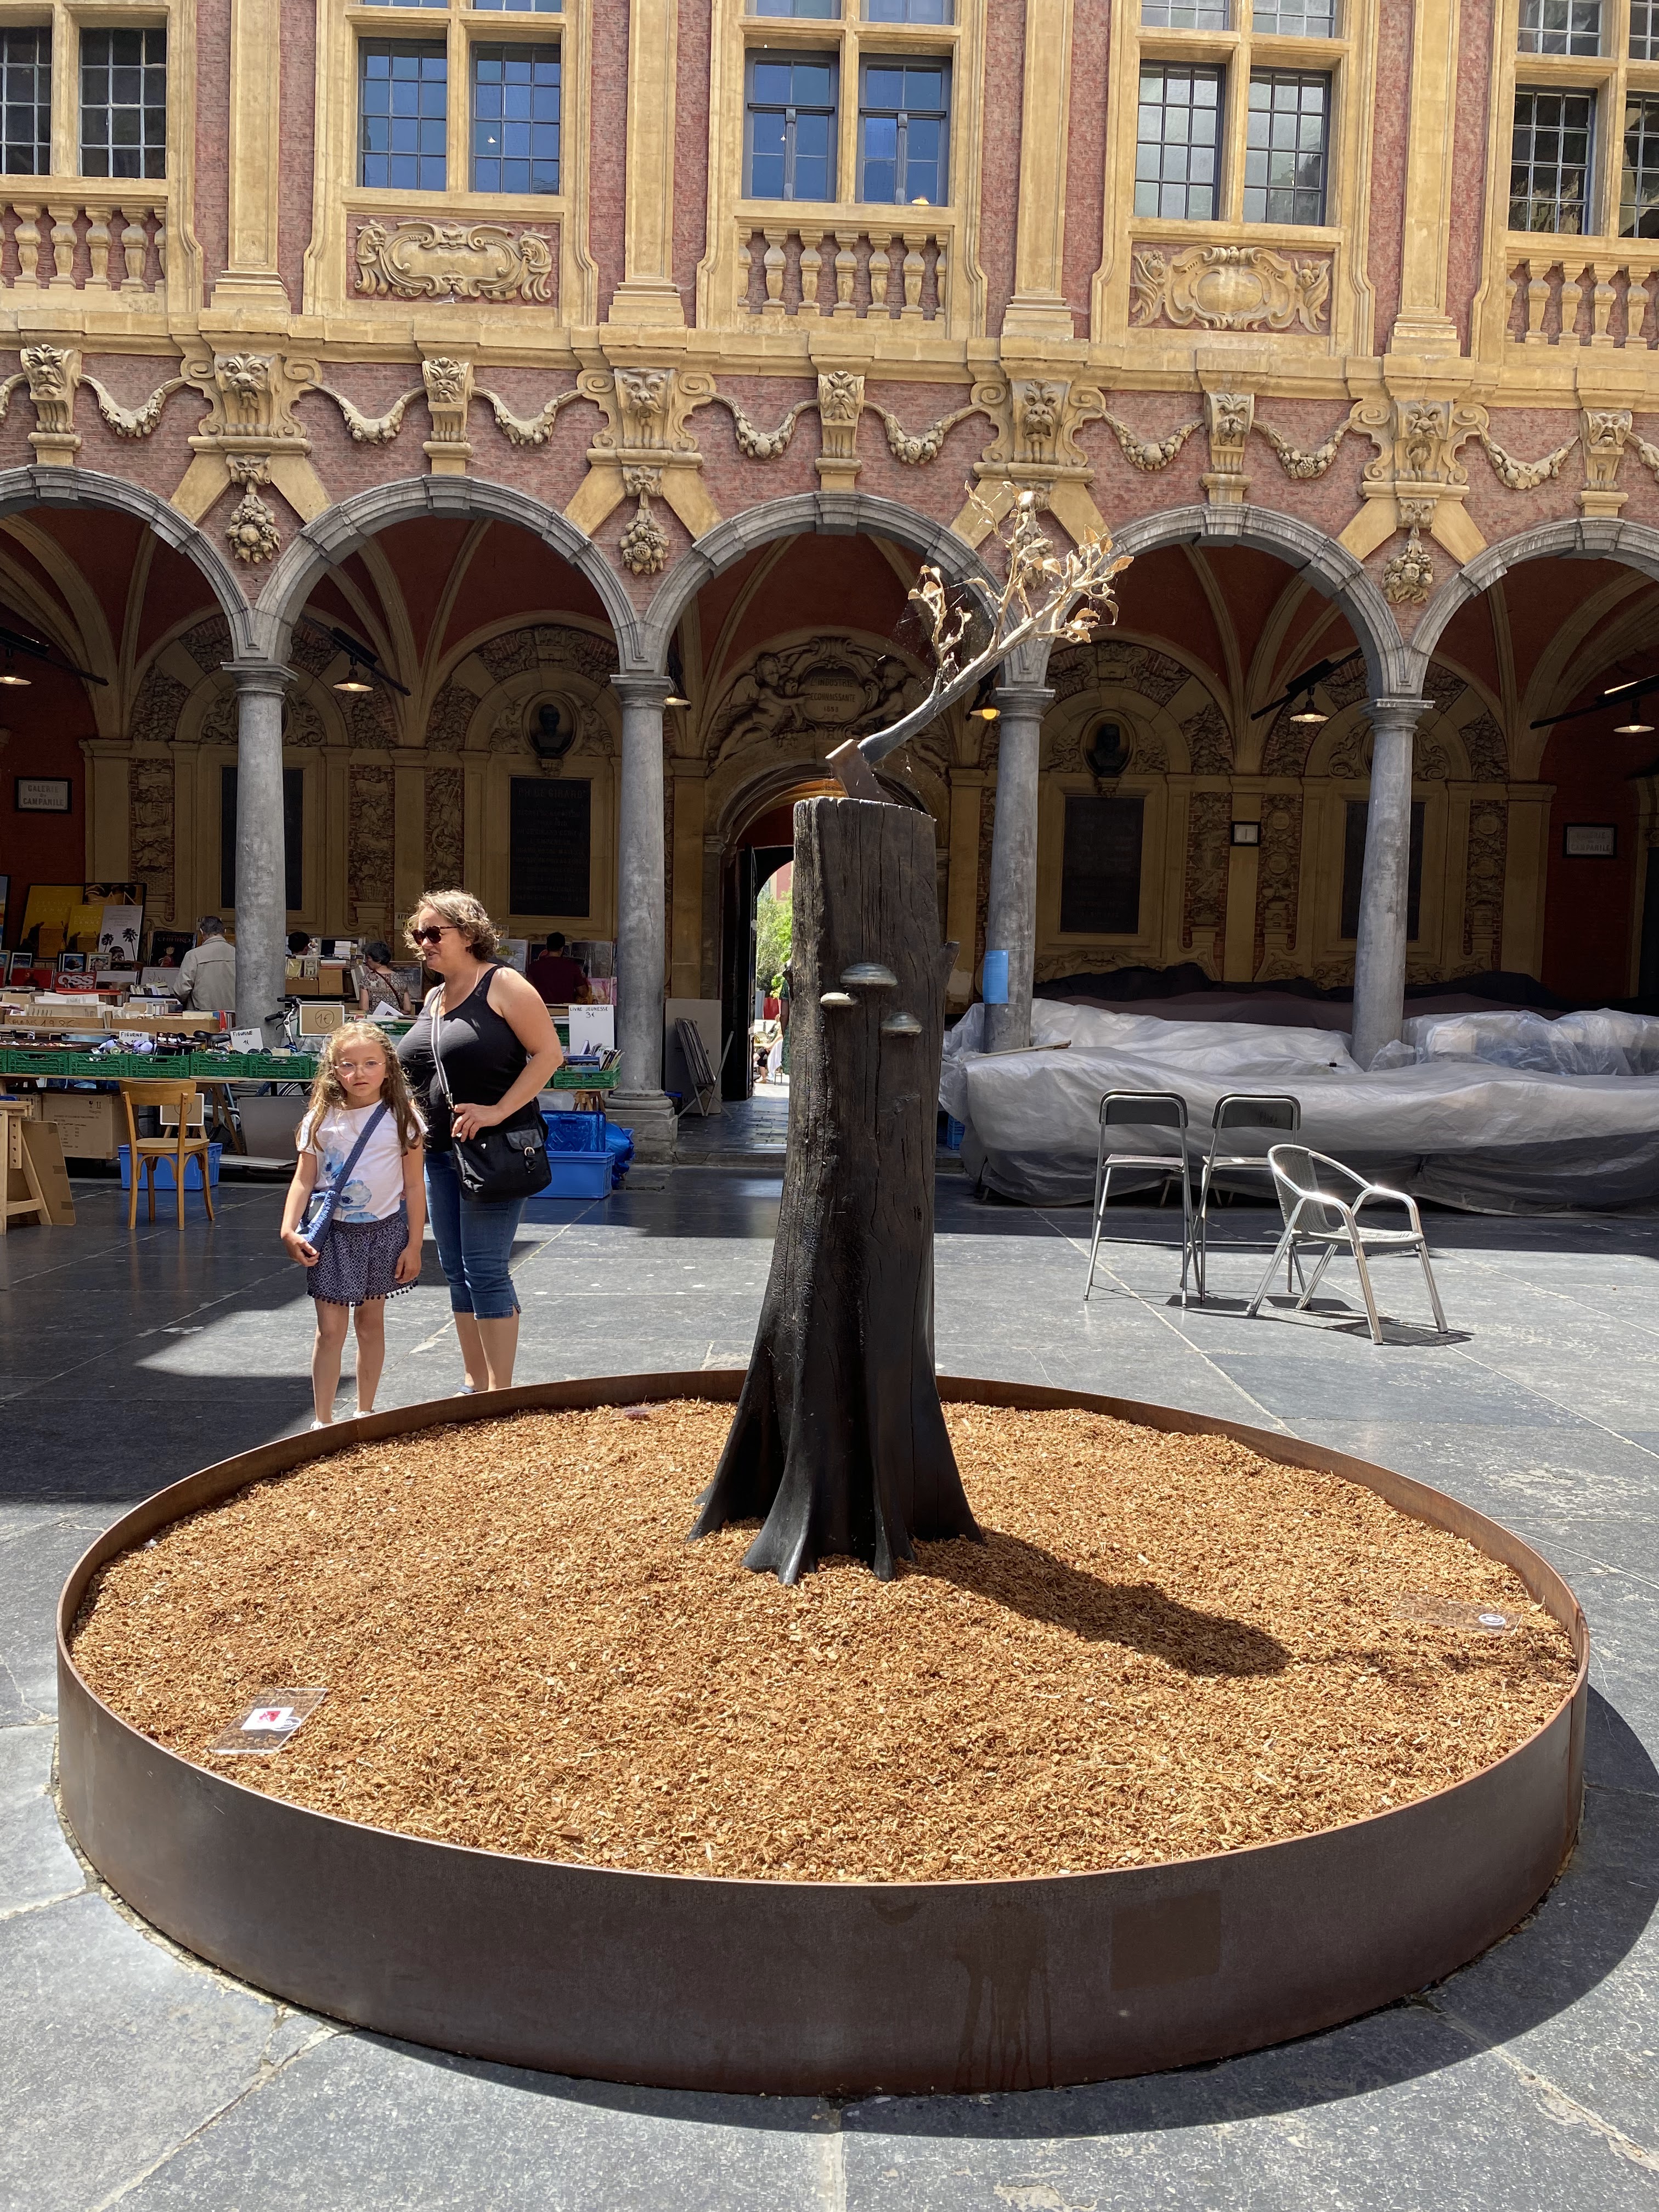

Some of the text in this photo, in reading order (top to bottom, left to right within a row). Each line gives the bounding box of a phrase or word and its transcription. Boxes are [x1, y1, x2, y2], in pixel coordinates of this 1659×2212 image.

[27, 785, 59, 793] GALERIE
[22, 798, 64, 806] CAMPANILE
[58, 974, 94, 985] OSS
[316, 1013, 332, 1024] 1€
